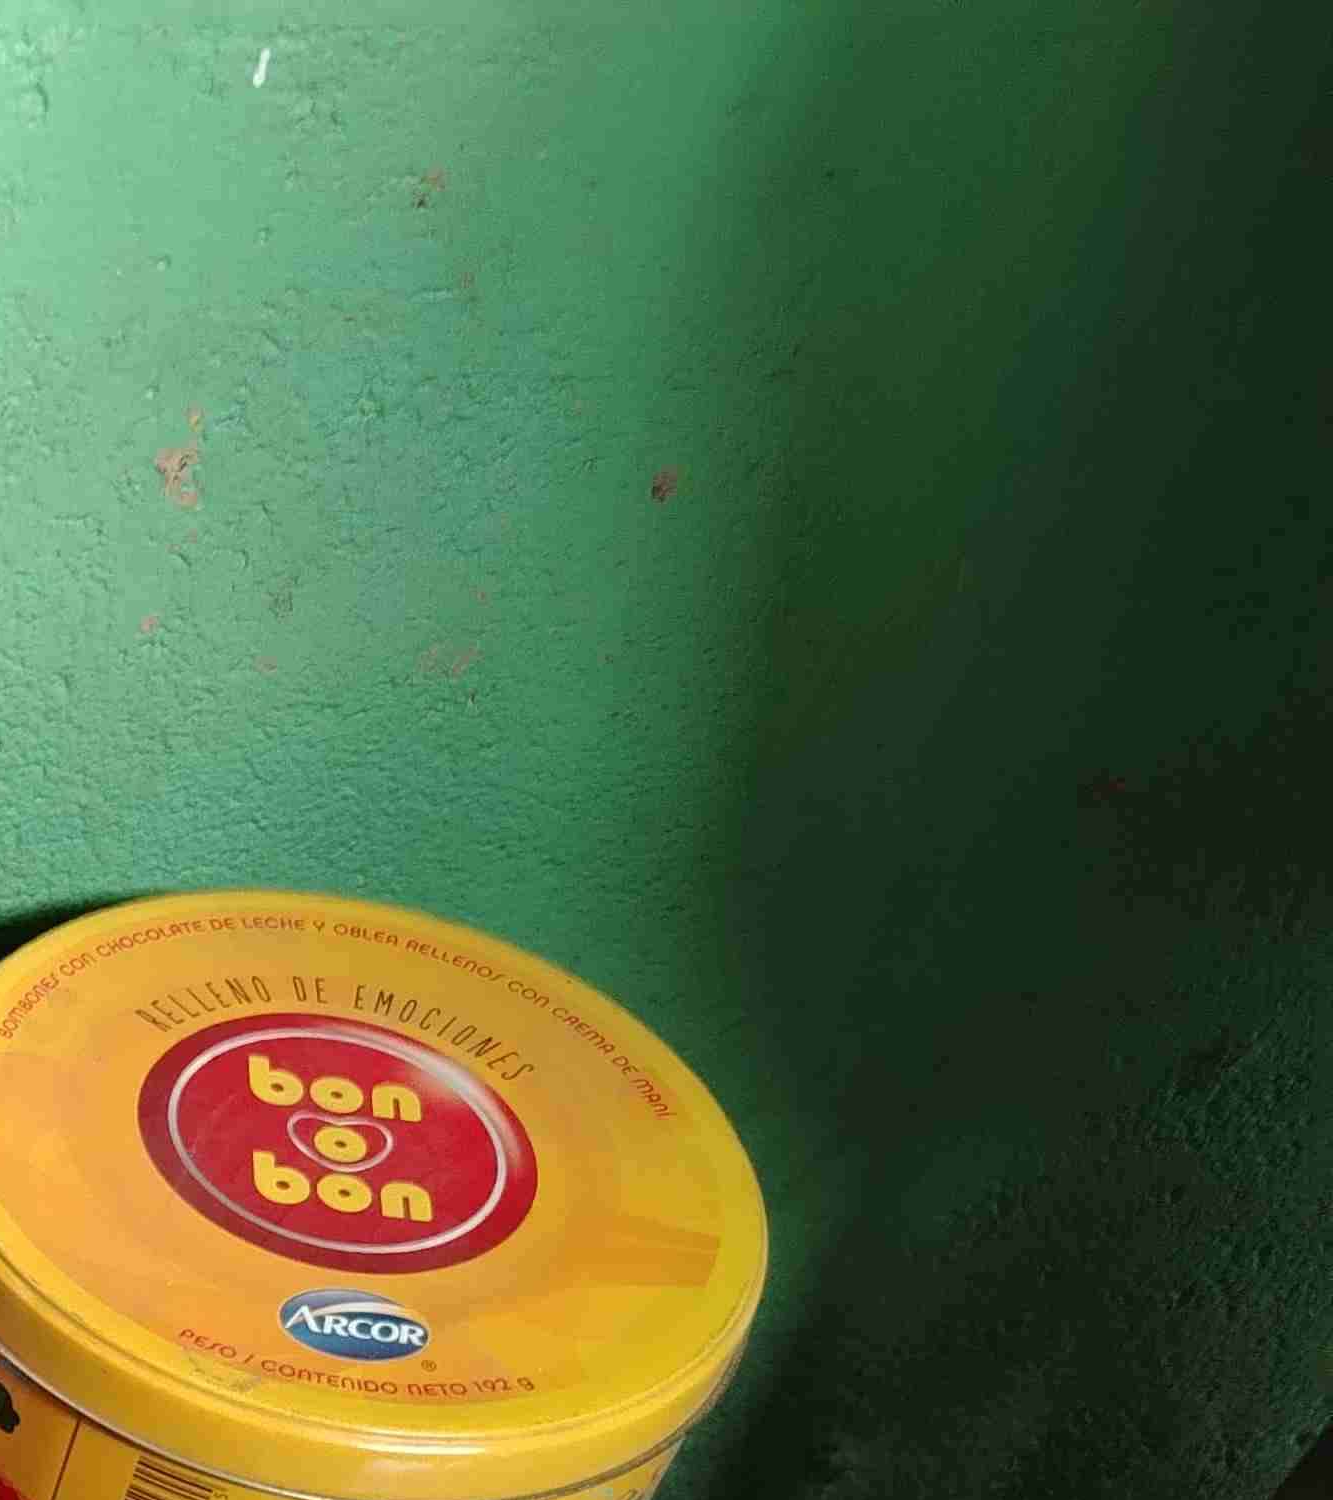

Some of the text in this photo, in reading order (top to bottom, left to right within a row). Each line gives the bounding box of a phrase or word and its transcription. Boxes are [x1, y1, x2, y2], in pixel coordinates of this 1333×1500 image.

[95, 919, 204, 960] CHOCOLATE
[208, 916, 235, 932] DE
[241, 917, 306, 932] LECHE
[313, 919, 327, 934] Y
[334, 922, 399, 947] OBLEA
[405, 938, 503, 985] RELLENOS
[550, 1005, 614, 1056] CREMA
[612, 1055, 639, 1077] DE
[134, 974, 534, 1082] RELLENO DE EMOCIONES
[247, 1054, 423, 1123] bon
[313, 1124, 368, 1164] o
[251, 1149, 434, 1223] bon
[284, 1304, 426, 1347] ARCOR
[177, 1328, 239, 1360] PESO
[260, 1357, 399, 1398] CONTENIDO
[406, 1381, 469, 1398] NETO
[474, 1375, 510, 1396] 192
